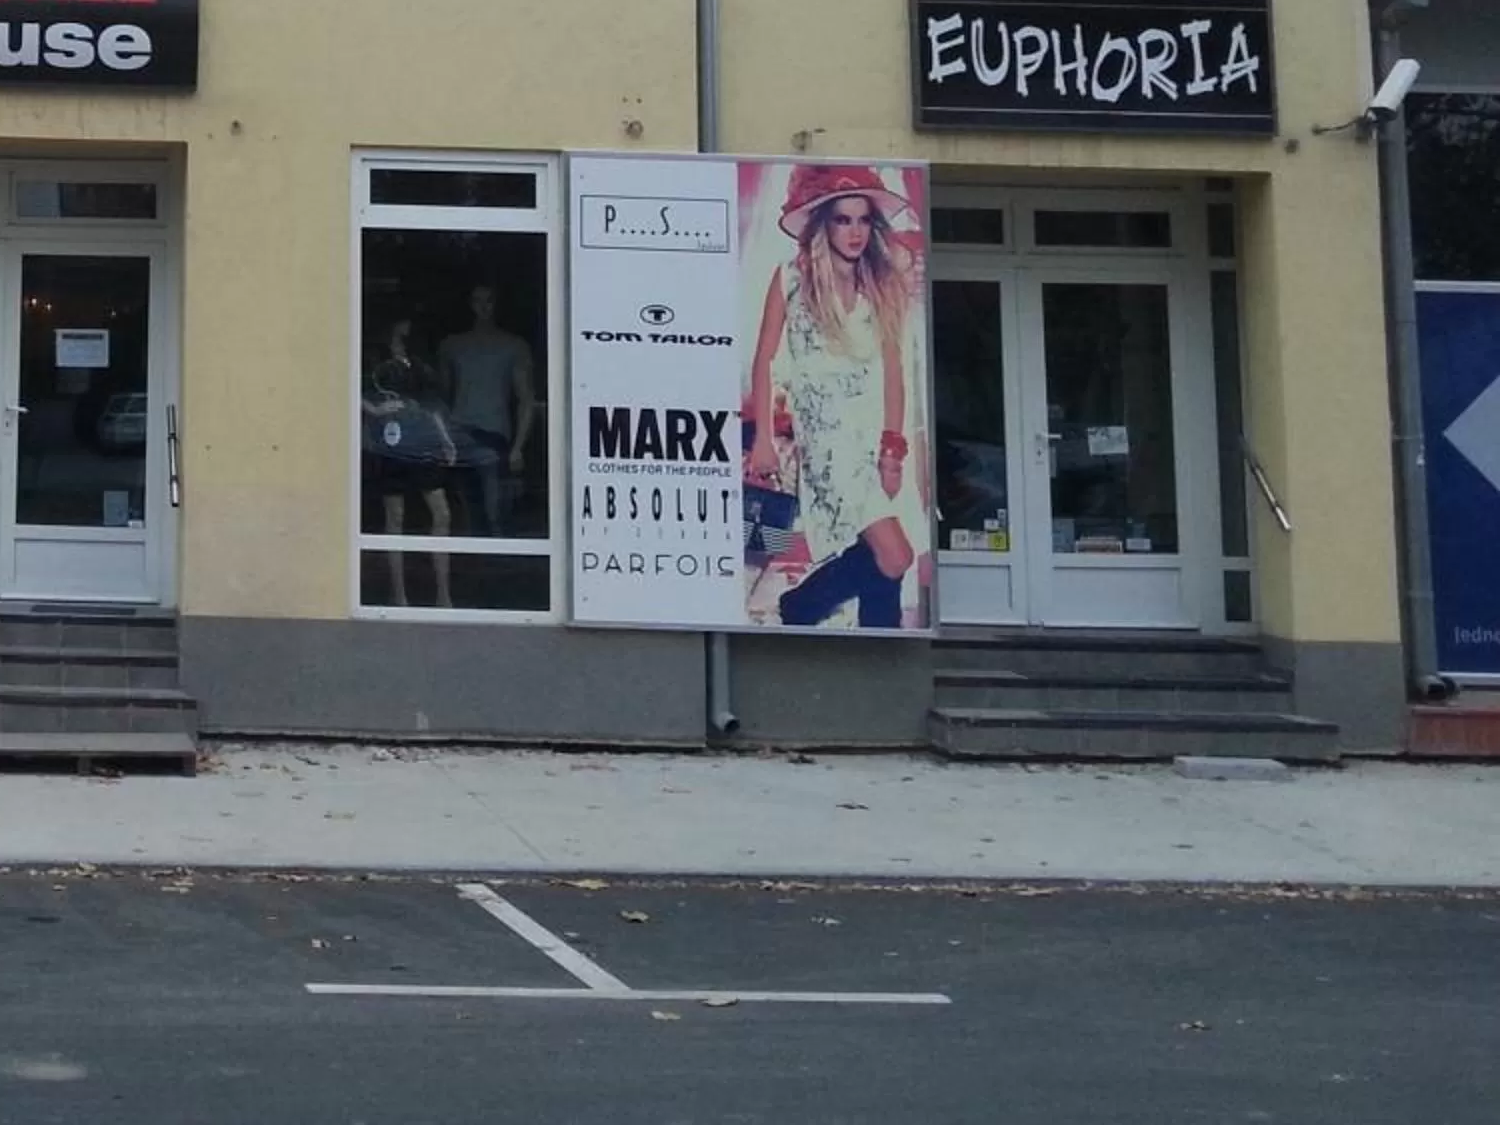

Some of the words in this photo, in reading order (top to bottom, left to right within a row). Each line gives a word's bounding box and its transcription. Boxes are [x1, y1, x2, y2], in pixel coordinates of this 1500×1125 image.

[926, 12, 1259, 103] EUPHORIA
[647, 333, 734, 347] TAILOR
[588, 406, 730, 463] MARX
[588, 462, 639, 475] CLOTHES
[641, 464, 663, 475] FOR
[665, 465, 686, 476] THE
[689, 466, 733, 477] PEOPLE
[582, 485, 730, 524] ABSOLUT
[581, 551, 735, 577] PARFOIS
